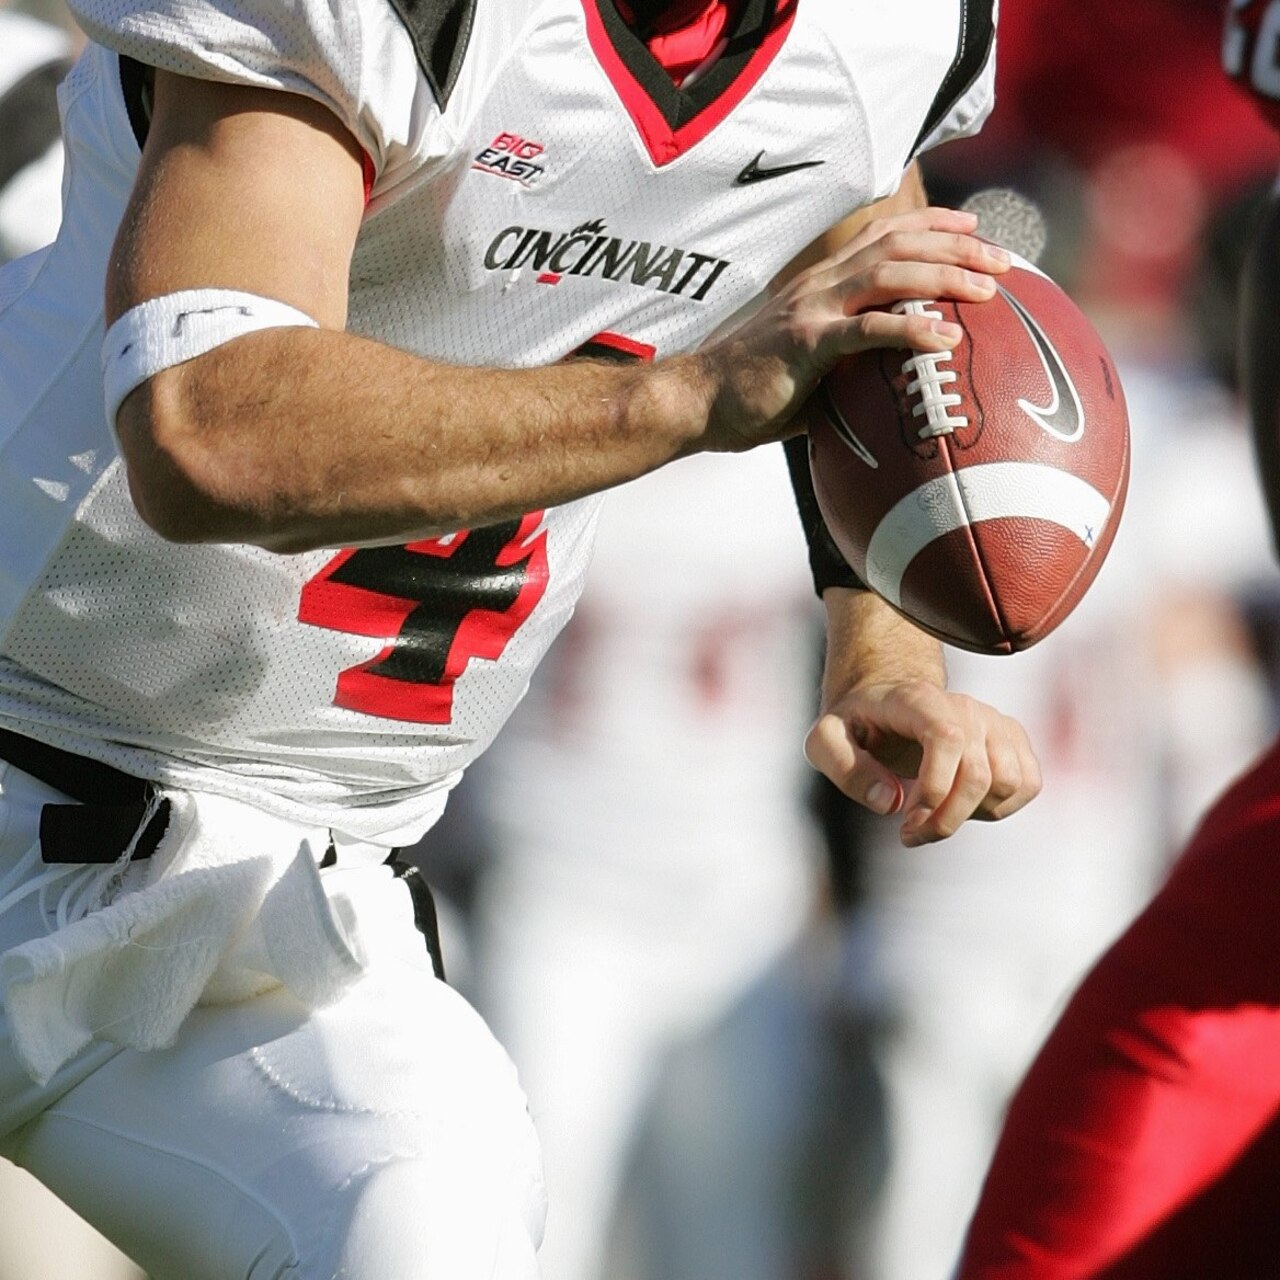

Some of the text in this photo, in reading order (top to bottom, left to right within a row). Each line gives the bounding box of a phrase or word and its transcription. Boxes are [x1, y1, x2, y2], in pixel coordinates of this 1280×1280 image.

[490, 131, 544, 160] BIG
[474, 148, 545, 180] EAST
[483, 219, 732, 302] CINCINNATI
